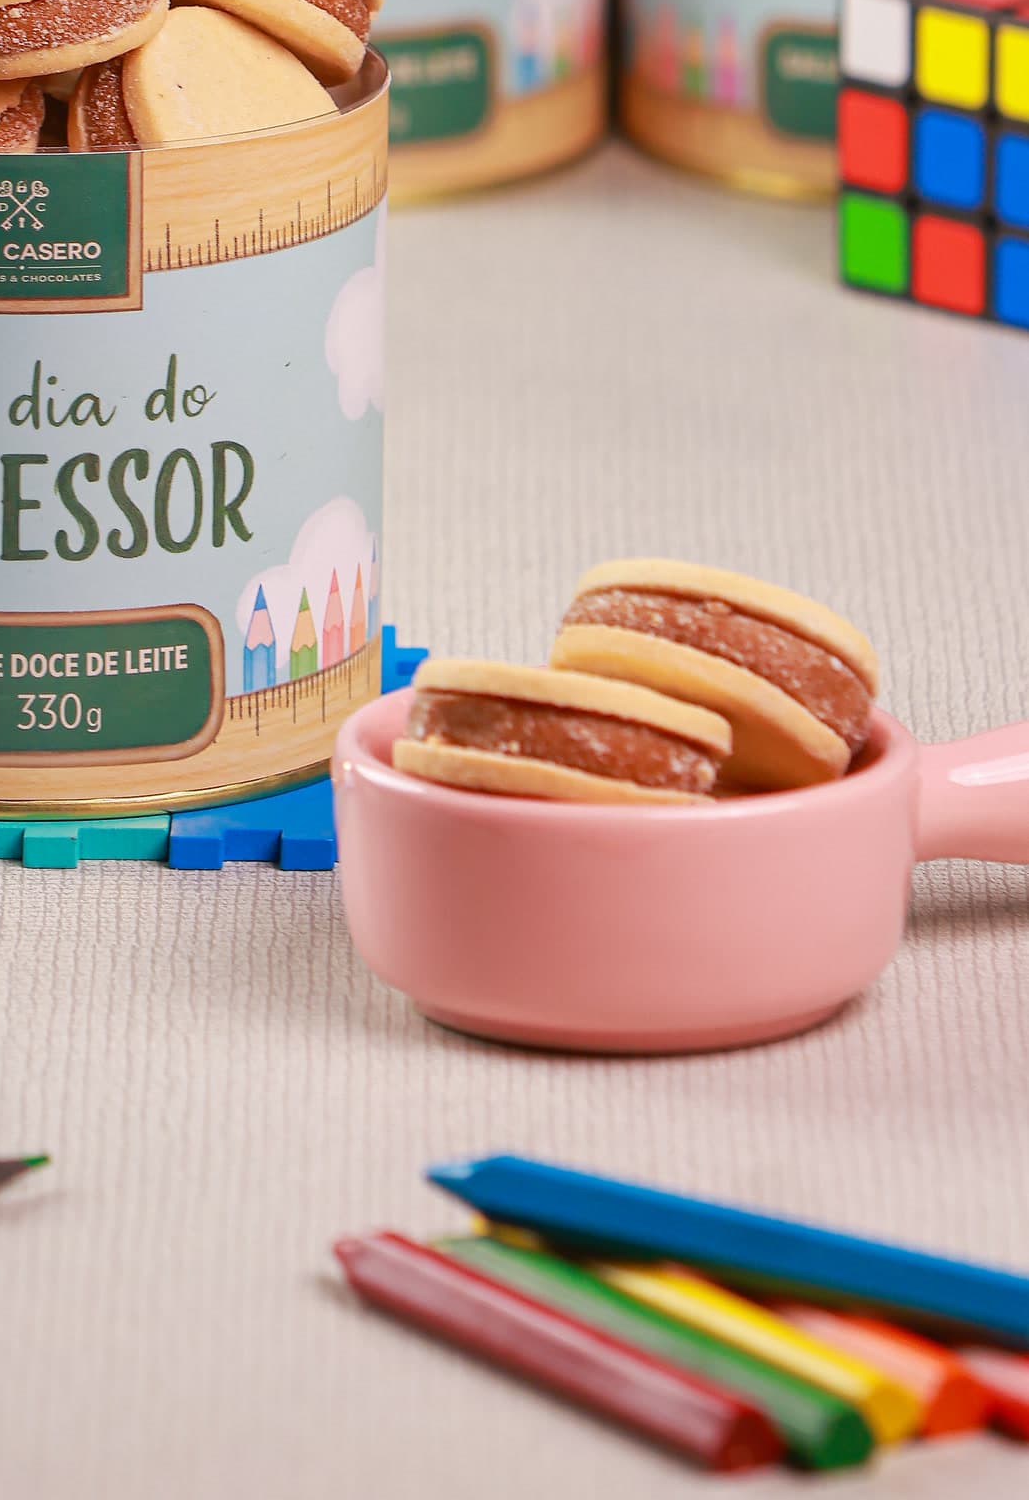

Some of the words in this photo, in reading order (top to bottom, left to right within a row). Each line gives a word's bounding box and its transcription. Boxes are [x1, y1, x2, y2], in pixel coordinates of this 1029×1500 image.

[3, 241, 102, 260] CASERO
[10, 275, 18, 283] &
[22, 273, 102, 283] CHOCOLATES
[9, 360, 116, 430] dia
[144, 353, 217, 423] do
[11, 652, 80, 678] DOCE
[85, 651, 119, 677] DE
[125, 644, 188, 675] LEITE
[17, 693, 102, 733] 330g
